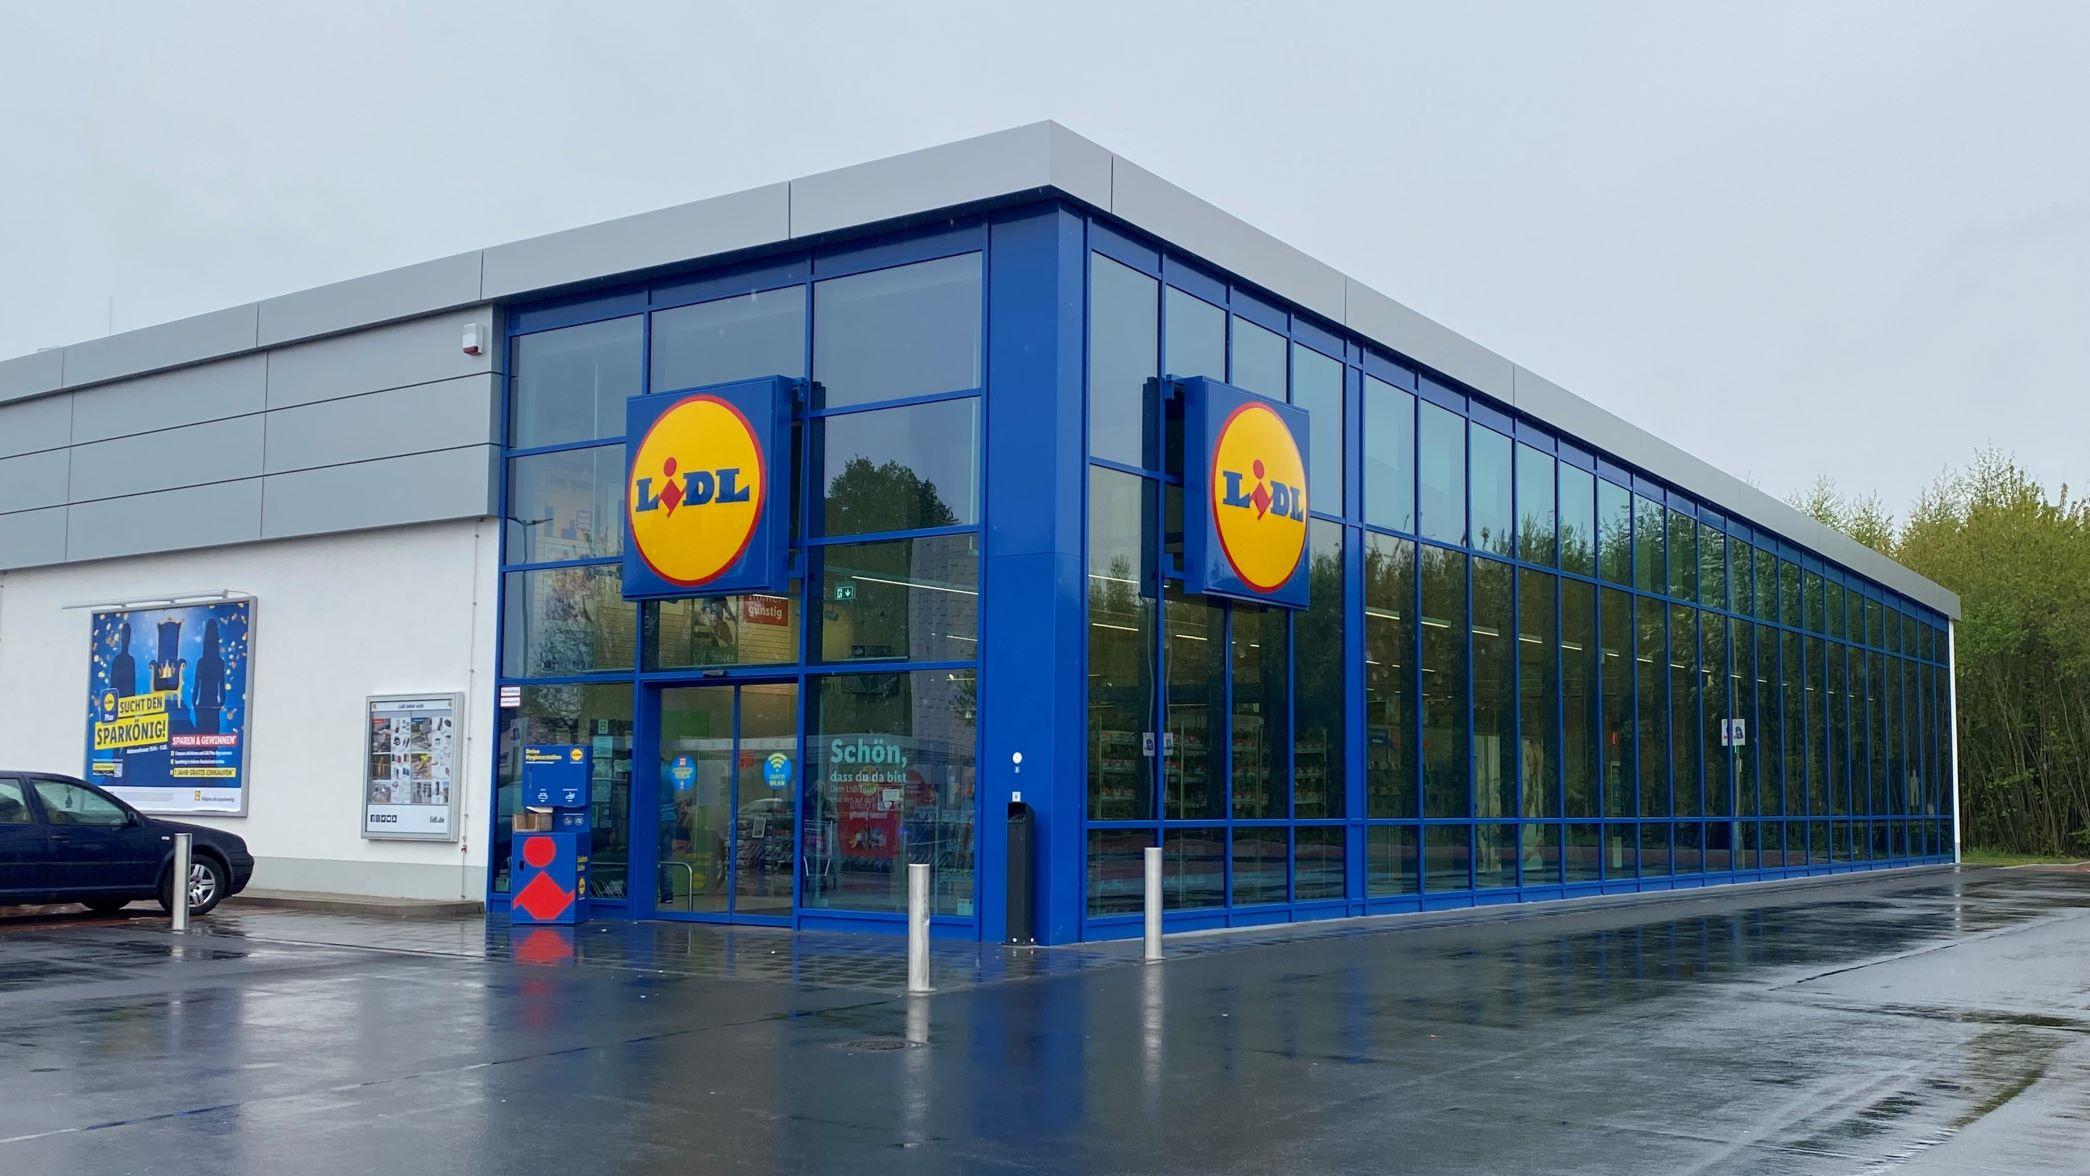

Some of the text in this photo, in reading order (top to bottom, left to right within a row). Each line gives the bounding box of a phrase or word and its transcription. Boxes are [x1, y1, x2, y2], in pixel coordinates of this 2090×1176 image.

[120, 696, 163, 714] SUCHT DEN
[96, 718, 166, 746] SPARKÖNIG!
[172, 736, 196, 746] SPAREN
[831, 738, 908, 768] Schön,
[830, 771, 907, 783] dass du da bist
[429, 815, 445, 824] lidl.de
